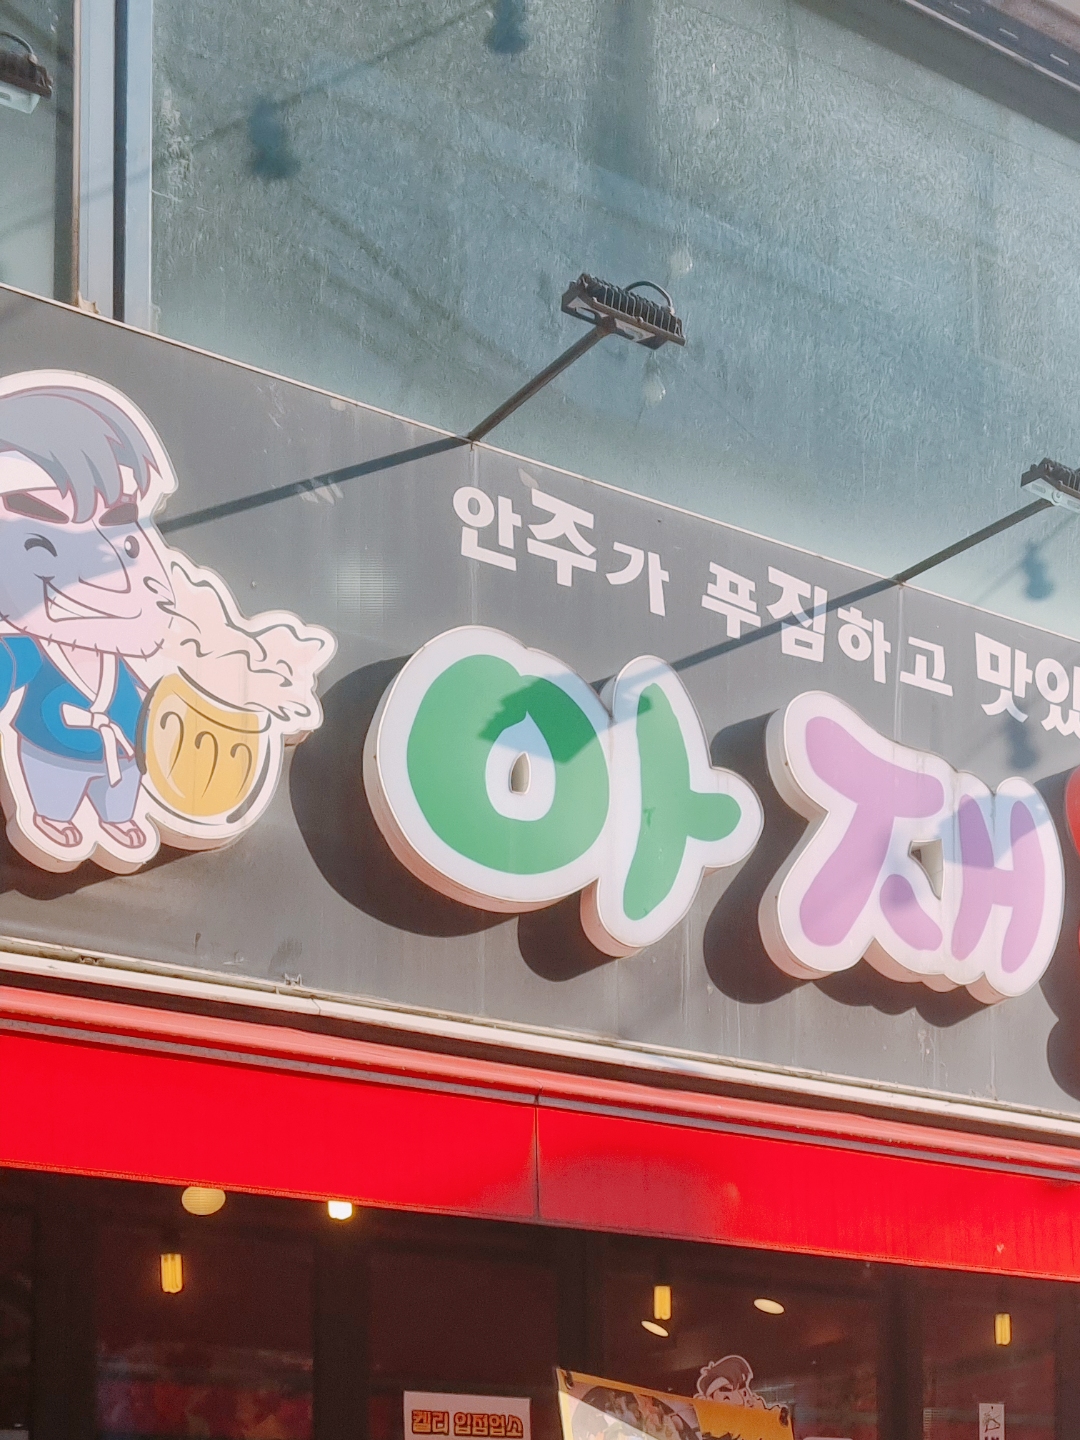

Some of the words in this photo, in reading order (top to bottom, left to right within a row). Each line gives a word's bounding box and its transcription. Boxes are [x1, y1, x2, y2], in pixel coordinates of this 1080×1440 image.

[453, 485, 670, 616] 안주가
[702, 562, 954, 697] 푸짐하고
[411, 1409, 449, 1435] 켈리
[454, 1410, 524, 1438] 입점업소
